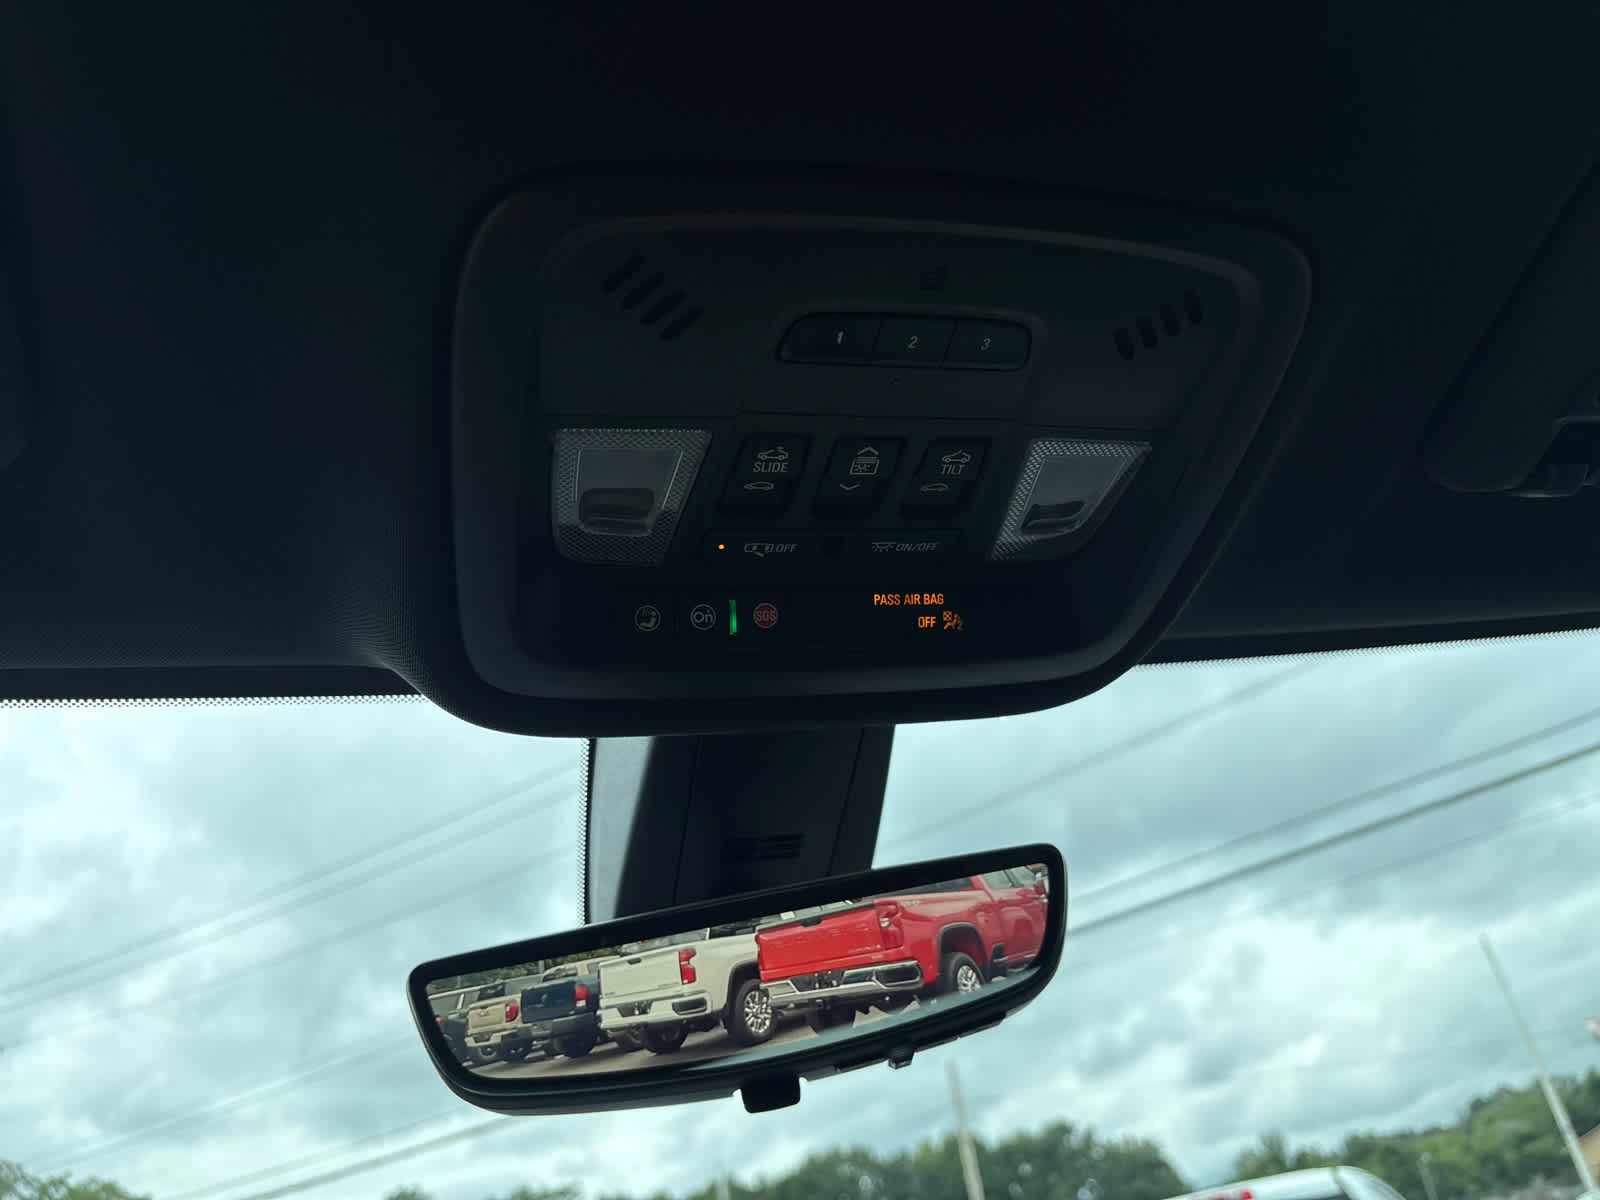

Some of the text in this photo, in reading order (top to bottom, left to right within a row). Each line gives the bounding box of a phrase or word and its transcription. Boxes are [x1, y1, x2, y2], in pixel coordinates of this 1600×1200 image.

[836, 329, 845, 344] 1
[907, 336, 919, 350] 2
[980, 338, 991, 351] 3
[752, 461, 789, 473] SLIDE
[941, 463, 966, 475] TILT
[774, 543, 799, 553] OFF
[873, 592, 945, 606] PASS AIR BAG
[694, 609, 713, 623] On
[756, 609, 777, 622] SOS
[917, 615, 937, 629] OFF
